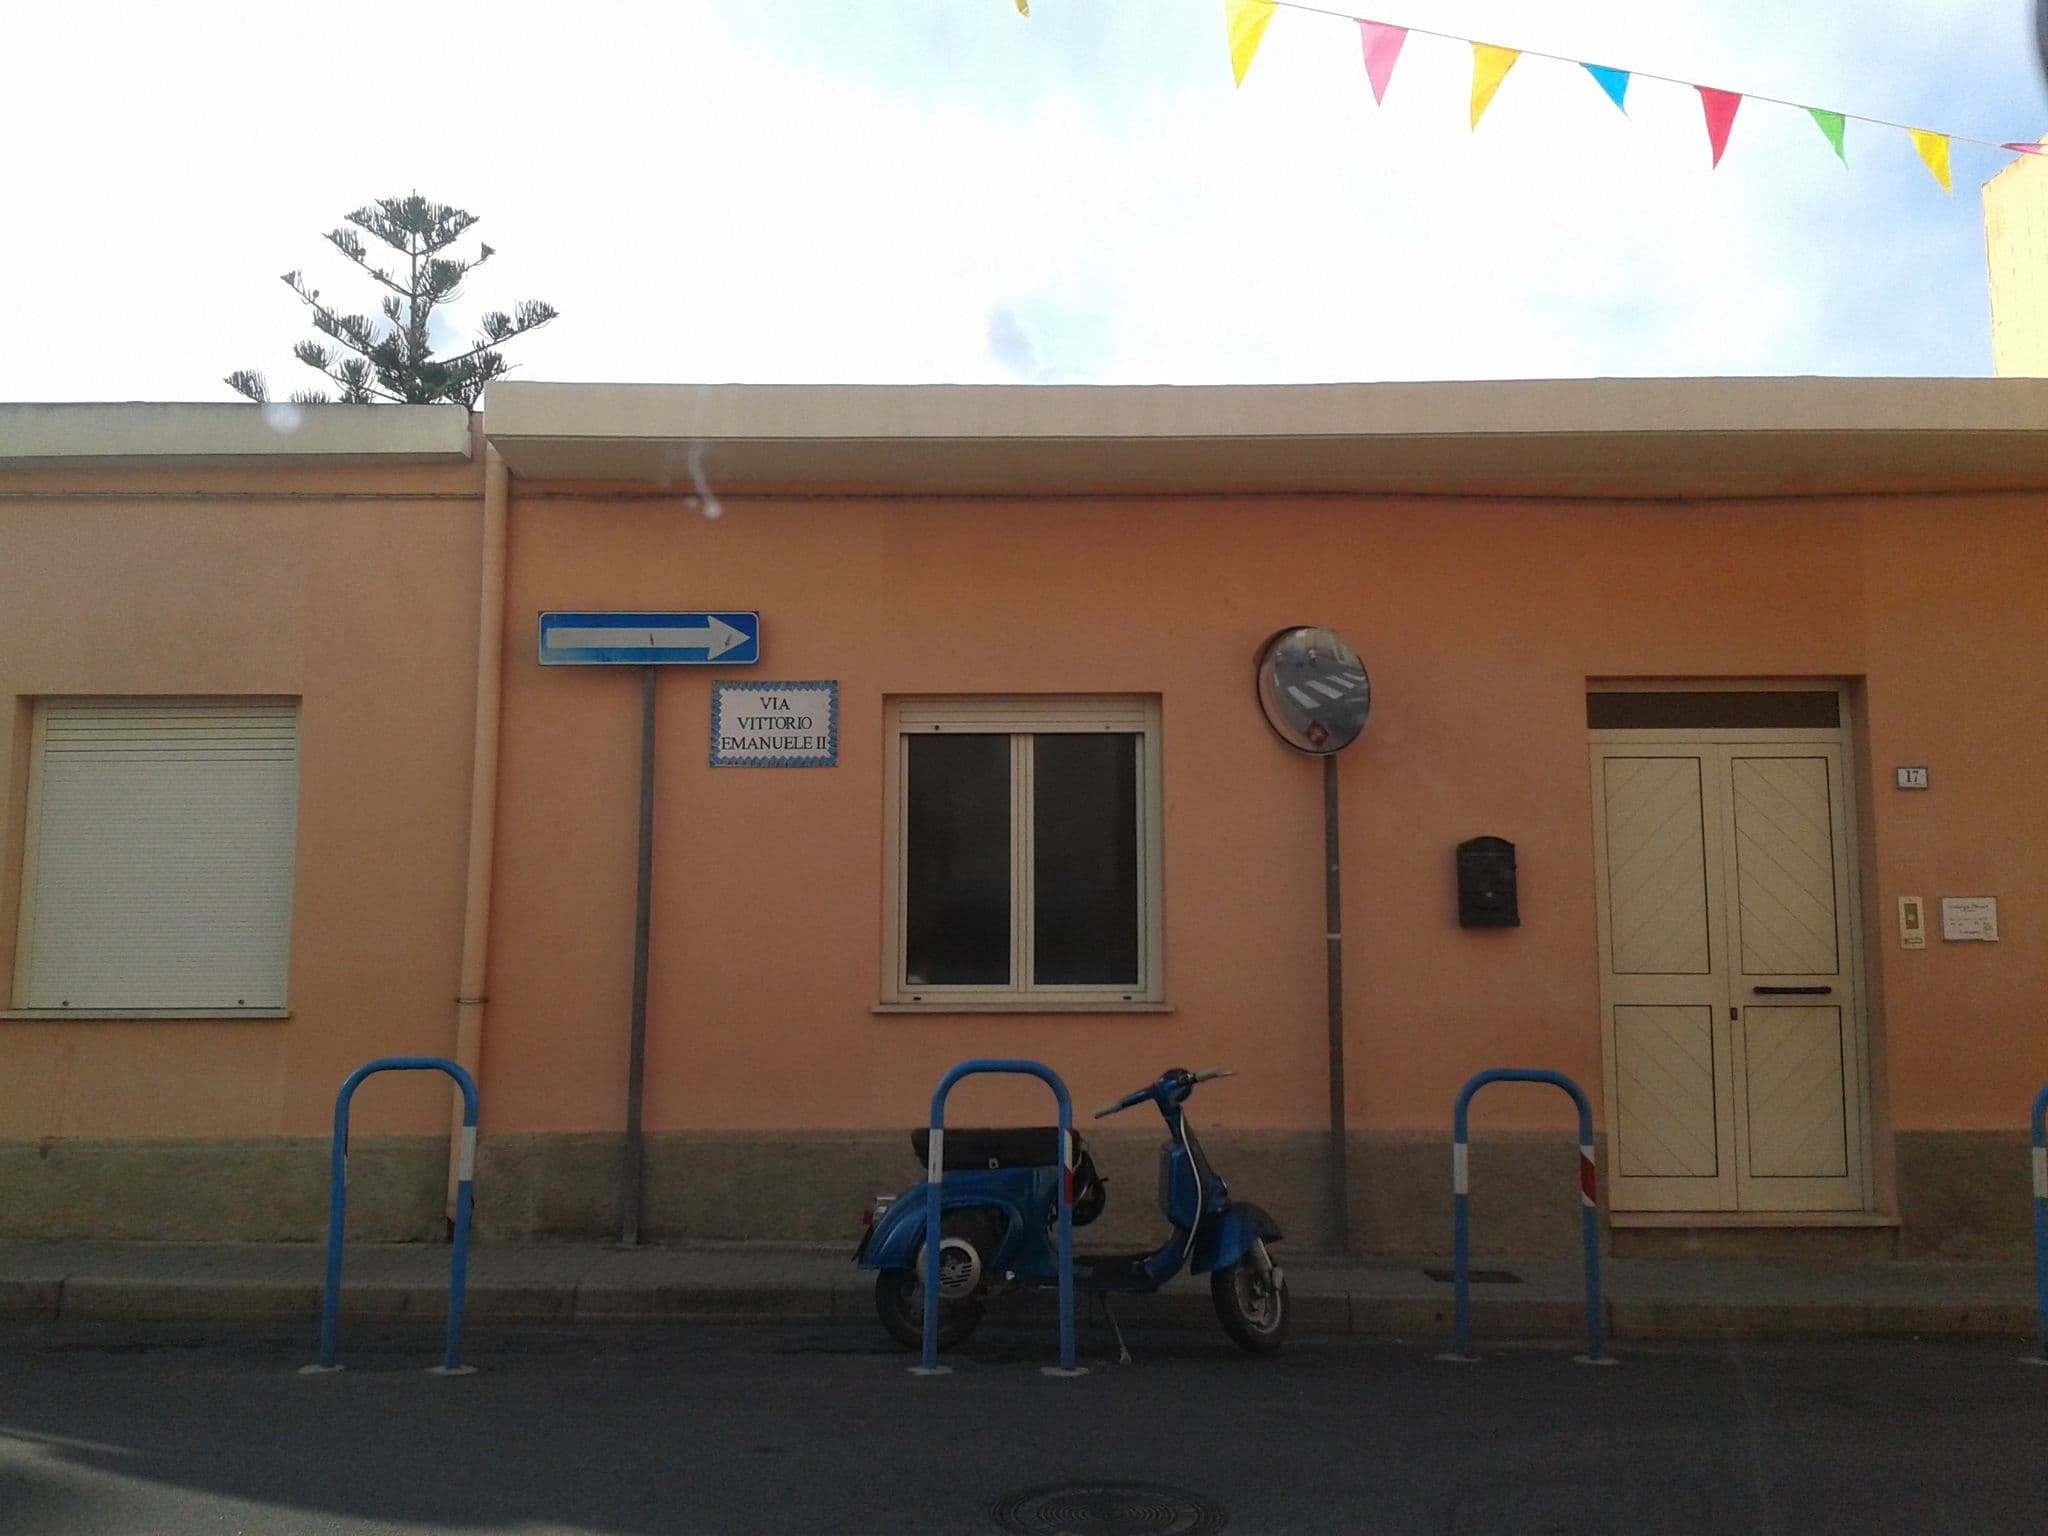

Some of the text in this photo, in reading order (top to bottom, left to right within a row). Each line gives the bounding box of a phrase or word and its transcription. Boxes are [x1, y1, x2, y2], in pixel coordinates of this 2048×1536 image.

[760, 697, 791, 711] VIA
[737, 716, 813, 730] VITTORIO
[721, 736, 827, 751] EMANUELE II
[1905, 770, 1920, 784] 17
